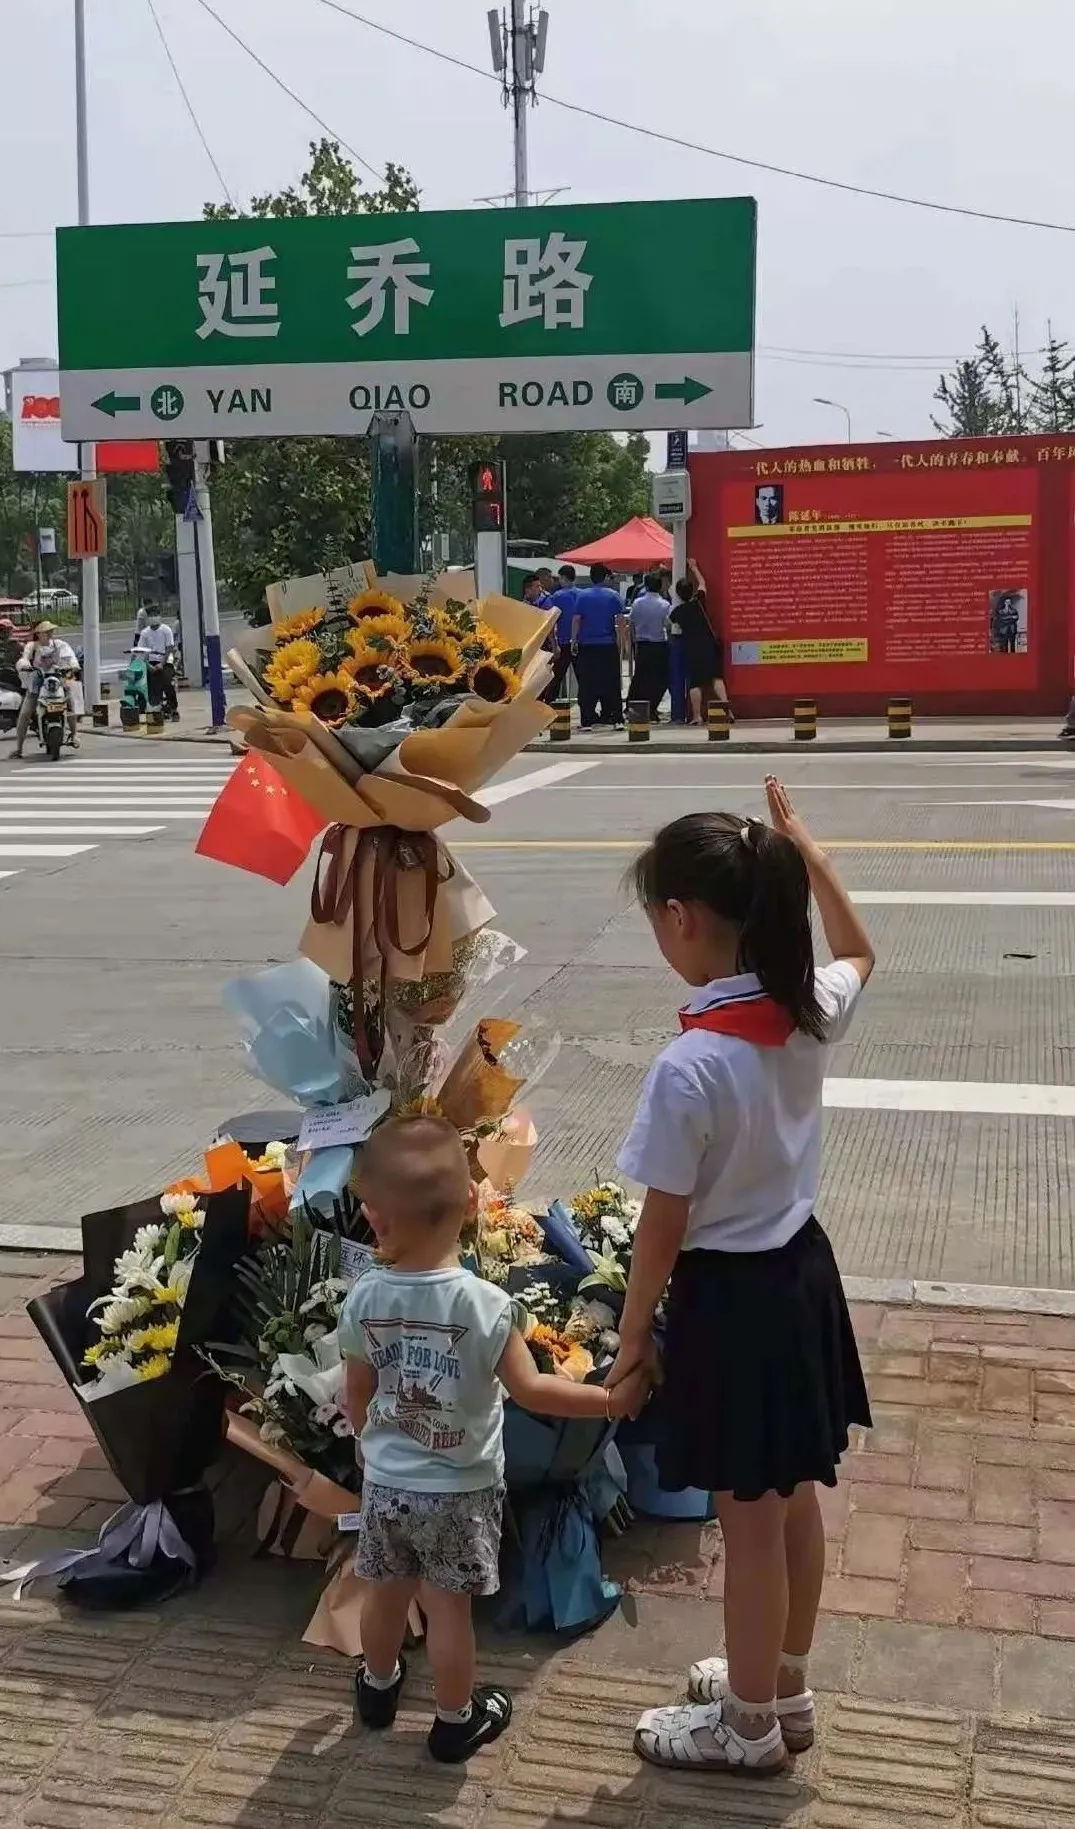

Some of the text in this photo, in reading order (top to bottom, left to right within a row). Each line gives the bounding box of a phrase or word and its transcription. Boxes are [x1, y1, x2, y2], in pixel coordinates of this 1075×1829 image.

[195, 231, 594, 340] 延乔路
[155, 389, 182, 416] 北
[206, 380, 594, 414] YAN QIAO ROAD
[613, 379, 638, 406] 南
[405, 1345, 432, 1368] FOR
[434, 1350, 462, 1380] LOVE
